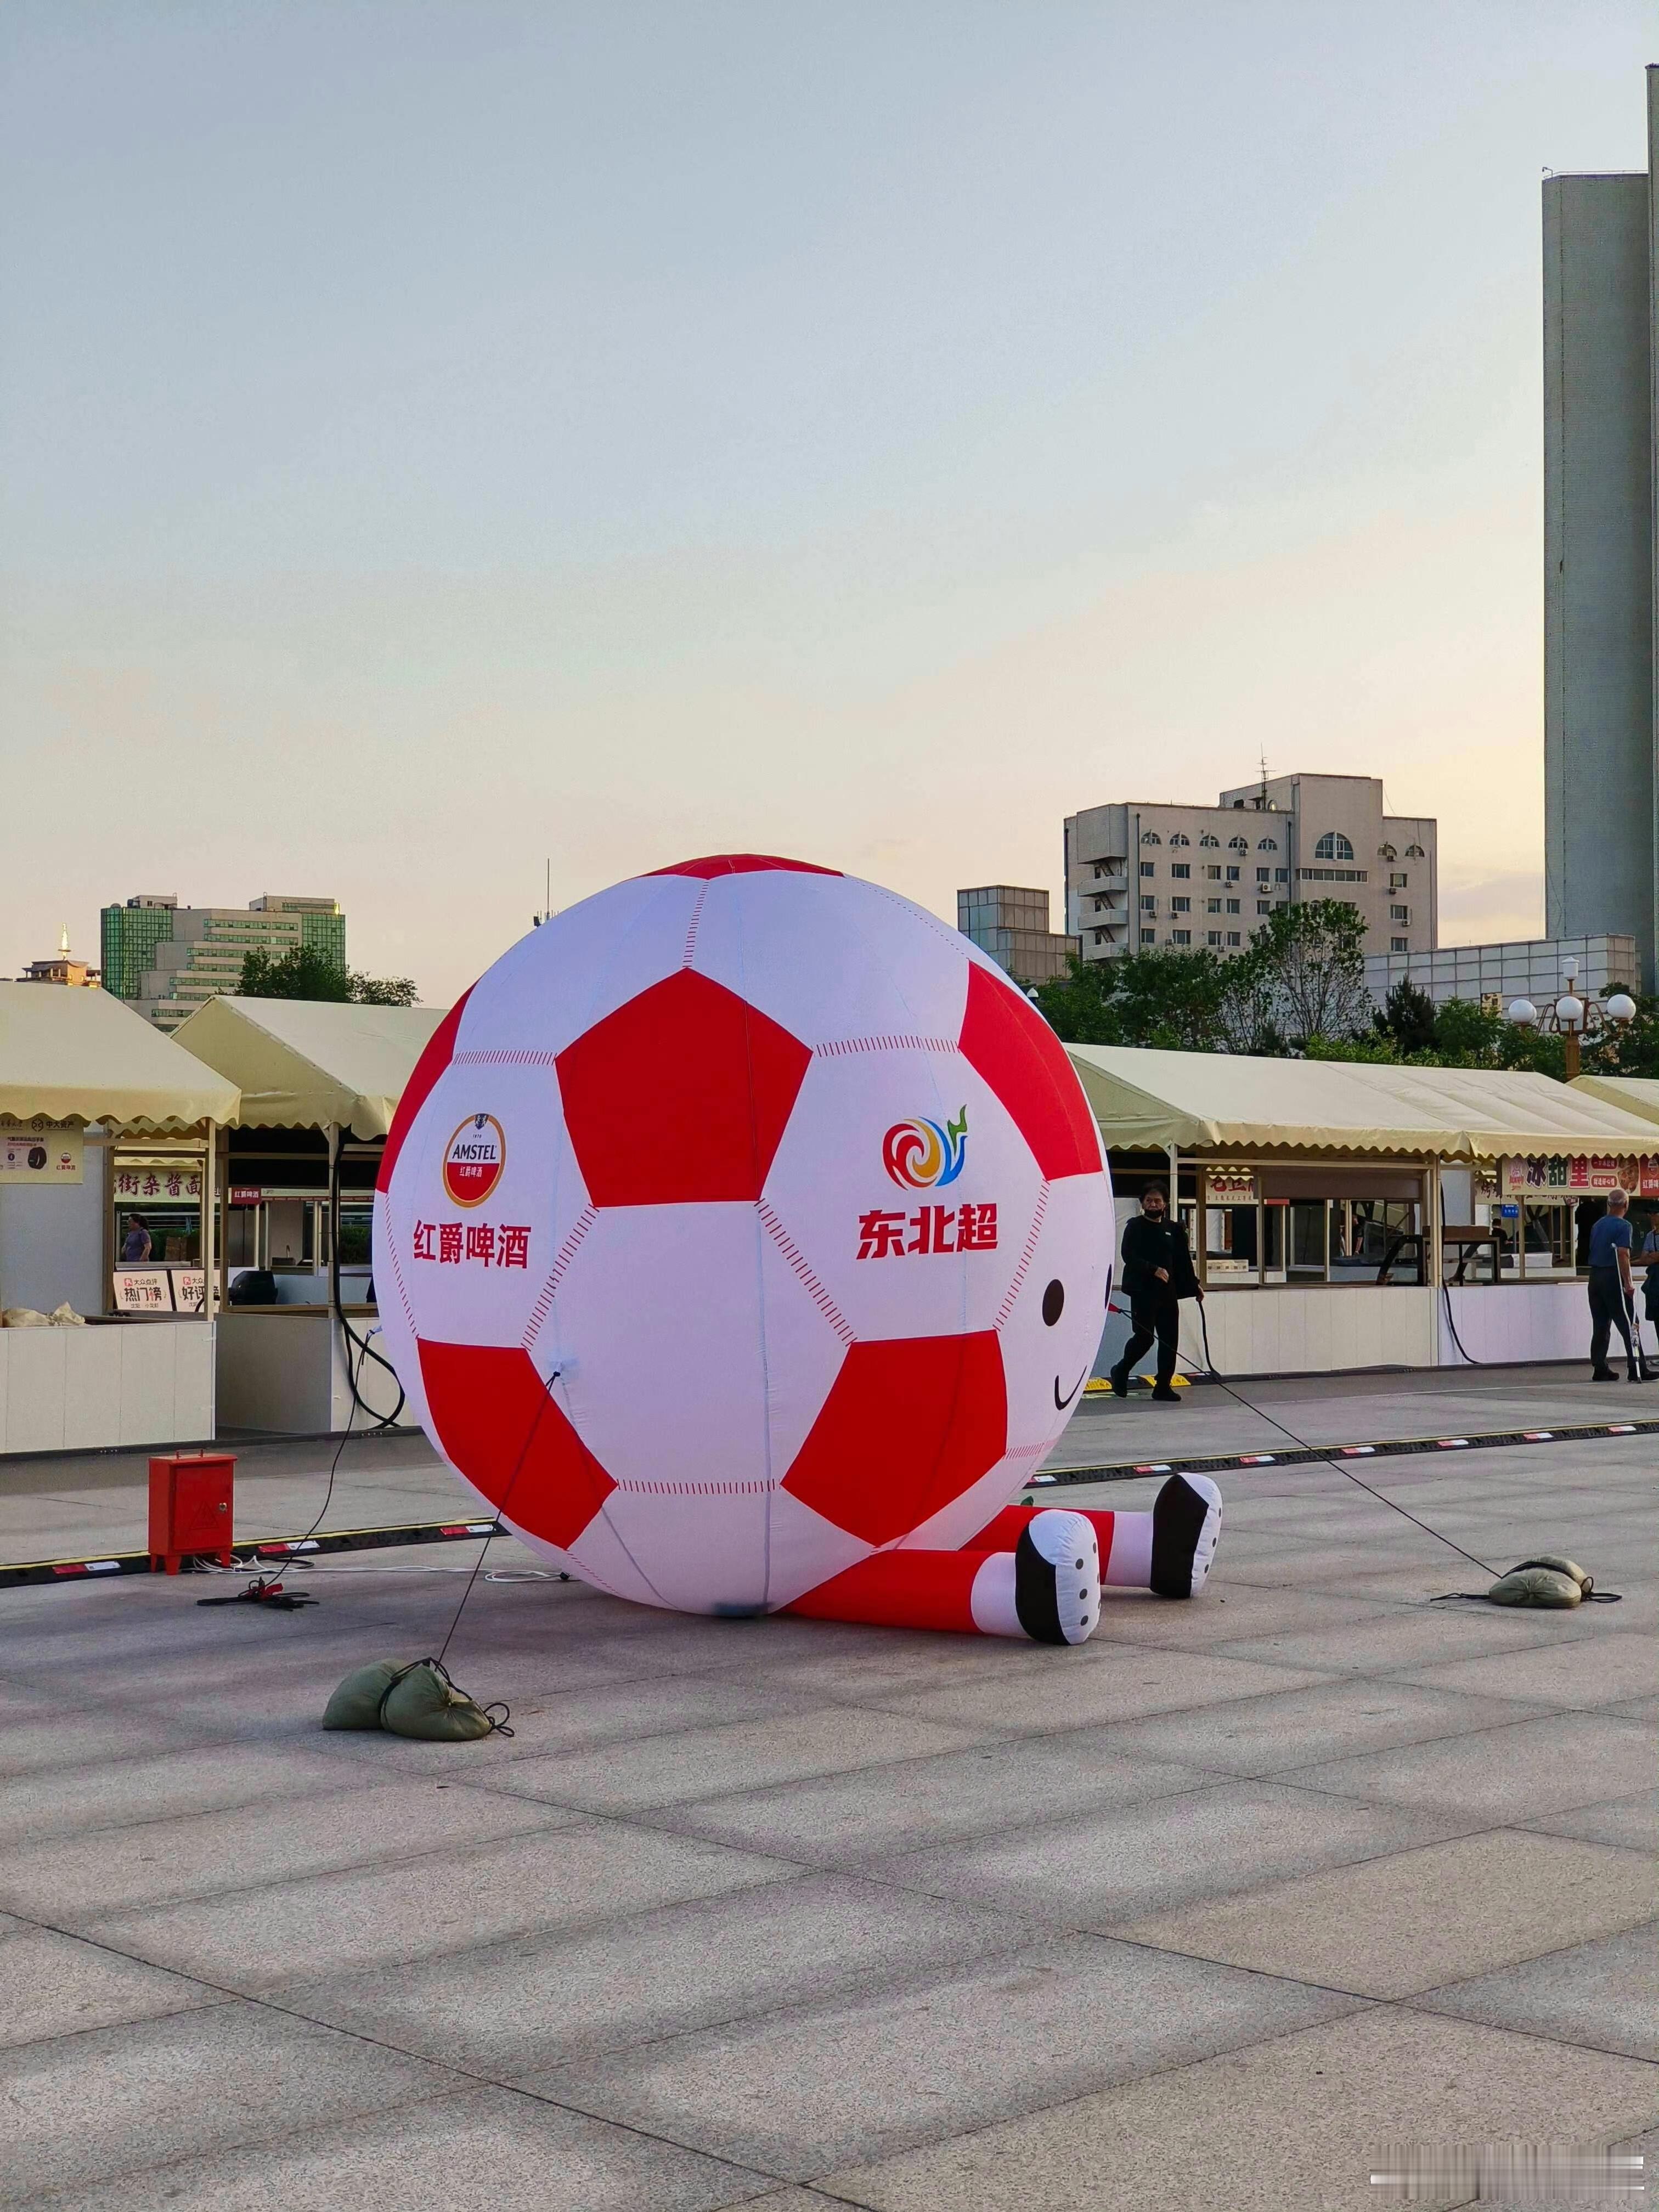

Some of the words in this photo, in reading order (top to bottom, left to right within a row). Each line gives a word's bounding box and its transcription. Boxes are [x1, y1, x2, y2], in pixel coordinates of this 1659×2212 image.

[452, 1144, 496, 1160] AMSTEL
[459, 1166, 483, 1177] 红爵啤酒
[114, 1172, 201, 1198] 街杂酱面
[234, 1190, 259, 1199] 红爵啤酒
[856, 1203, 998, 1260] 东北超
[414, 1220, 532, 1269] 红爵啤酒
[124, 1286, 162, 1302] 热门榜
